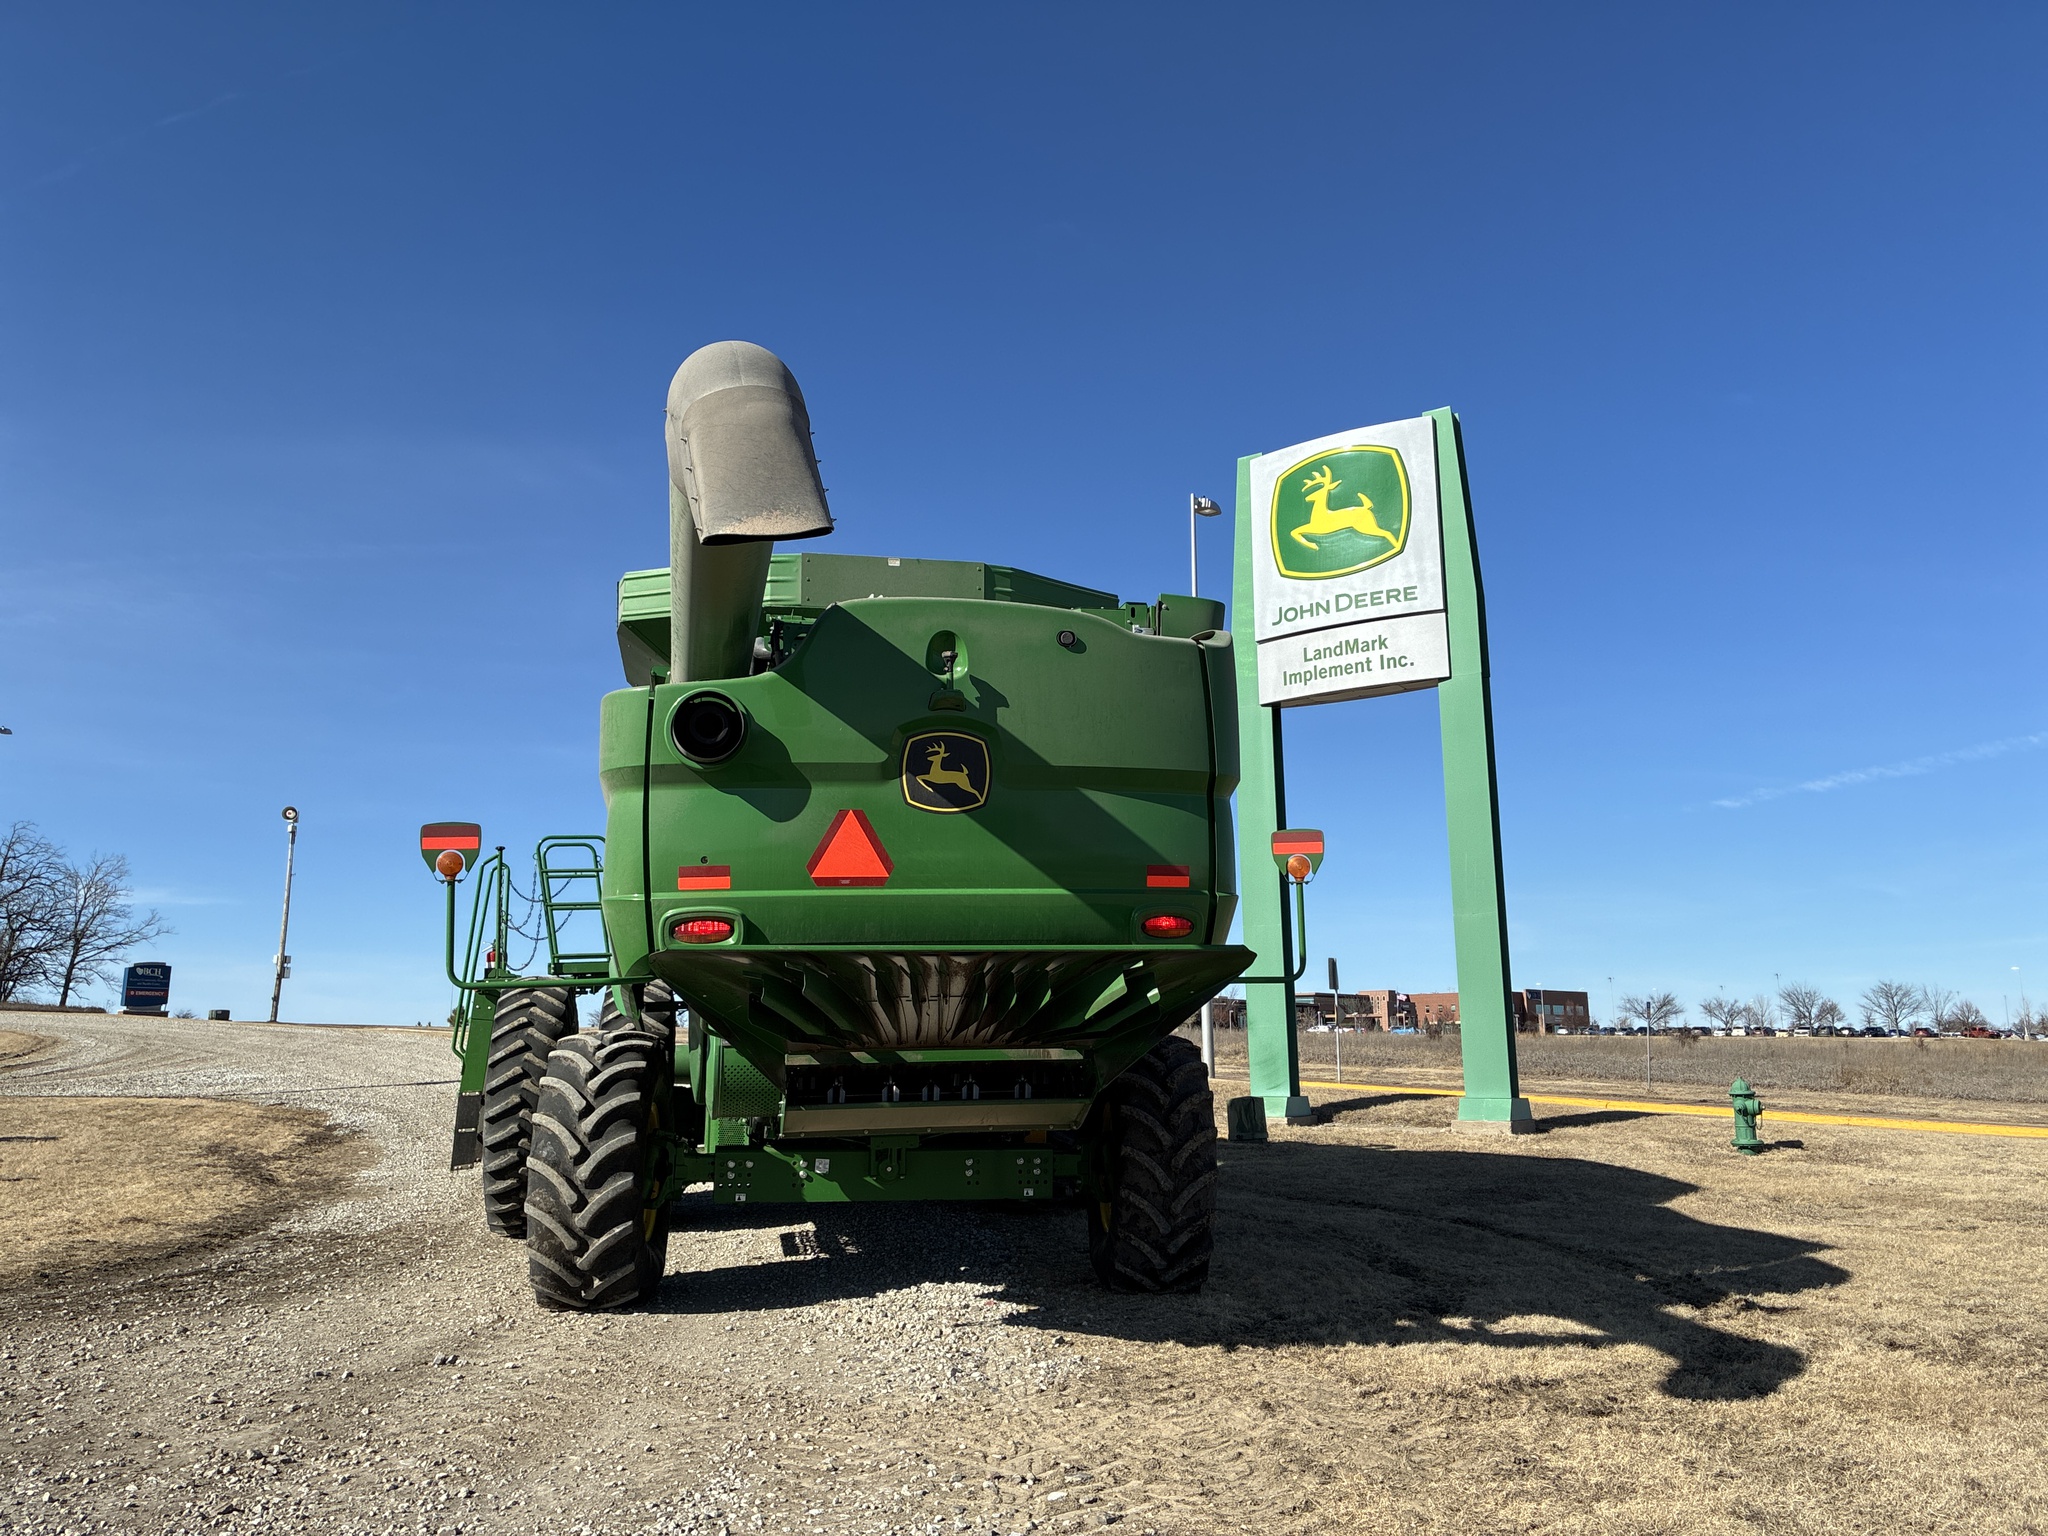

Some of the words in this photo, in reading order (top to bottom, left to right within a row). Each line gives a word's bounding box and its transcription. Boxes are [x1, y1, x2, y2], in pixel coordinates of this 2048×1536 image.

[1272, 600, 1330, 626] JOHN
[1335, 585, 1418, 612] DEERE
[1303, 635, 1388, 663] LandMark
[1283, 655, 1373, 686] Implement
[1380, 654, 1414, 670] Inc.
